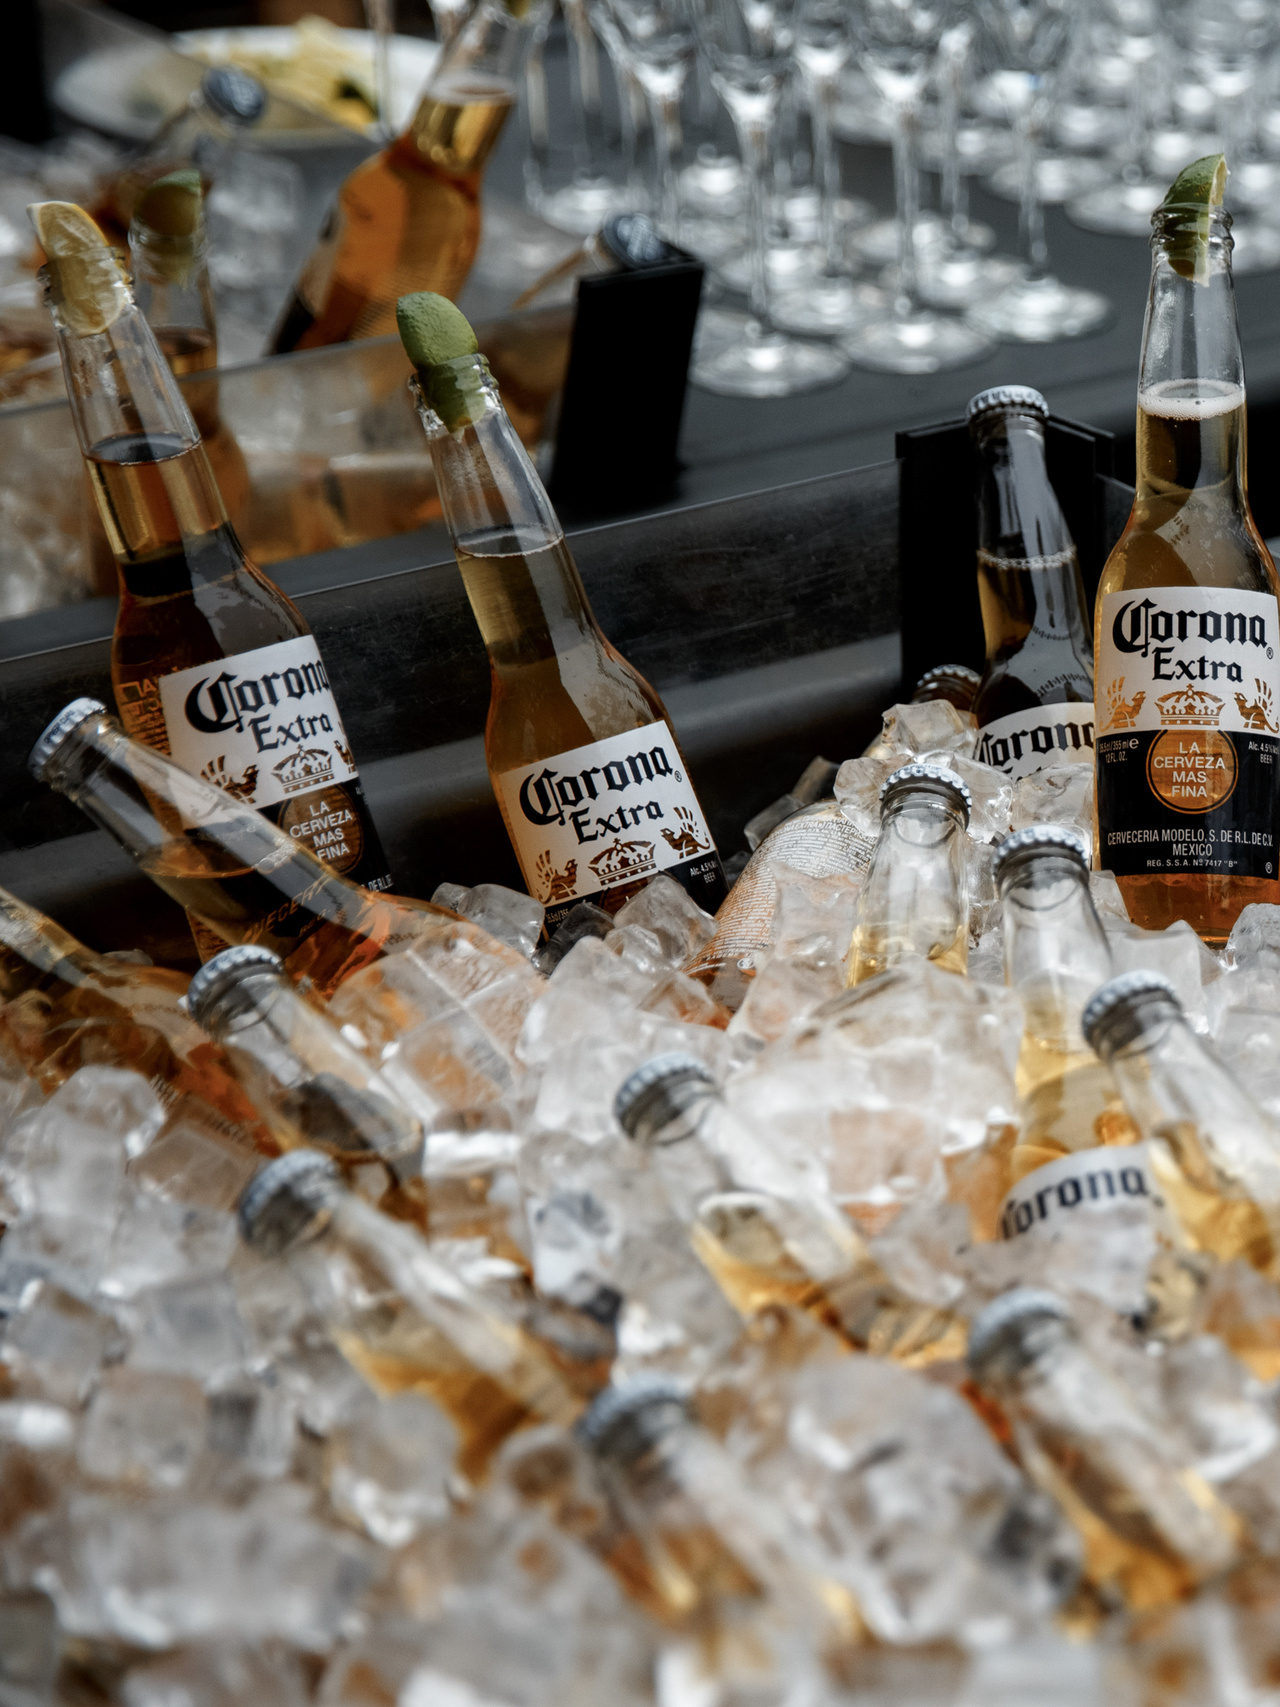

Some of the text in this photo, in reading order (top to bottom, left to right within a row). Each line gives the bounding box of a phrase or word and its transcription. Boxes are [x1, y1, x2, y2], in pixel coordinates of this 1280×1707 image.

[1112, 598, 1268, 658] Corona
[1152, 646, 1243, 683] Extra
[184, 659, 332, 734] Corona
[247, 712, 334, 754] Extra
[1179, 742, 1200, 754] LA
[1153, 756, 1226, 770] CERVEZA
[1260, 753, 1273, 765] BEER
[1172, 771, 1207, 783] MAS
[519, 746, 673, 827] Corona
[1171, 785, 1208, 798] FINA
[309, 801, 330, 818] LA
[289, 808, 353, 839] CERVEZA
[568, 800, 665, 845] Extra
[312, 828, 344, 848] MAS
[1107, 829, 1160, 846] CERVECERIA
[1161, 828, 1208, 845] MODELO,
[1220, 829, 1233, 844] DE
[1172, 843, 1213, 857] MEXICO
[1146, 859, 1165, 868] REG.
[1204, 859, 1222, 868] 7417
